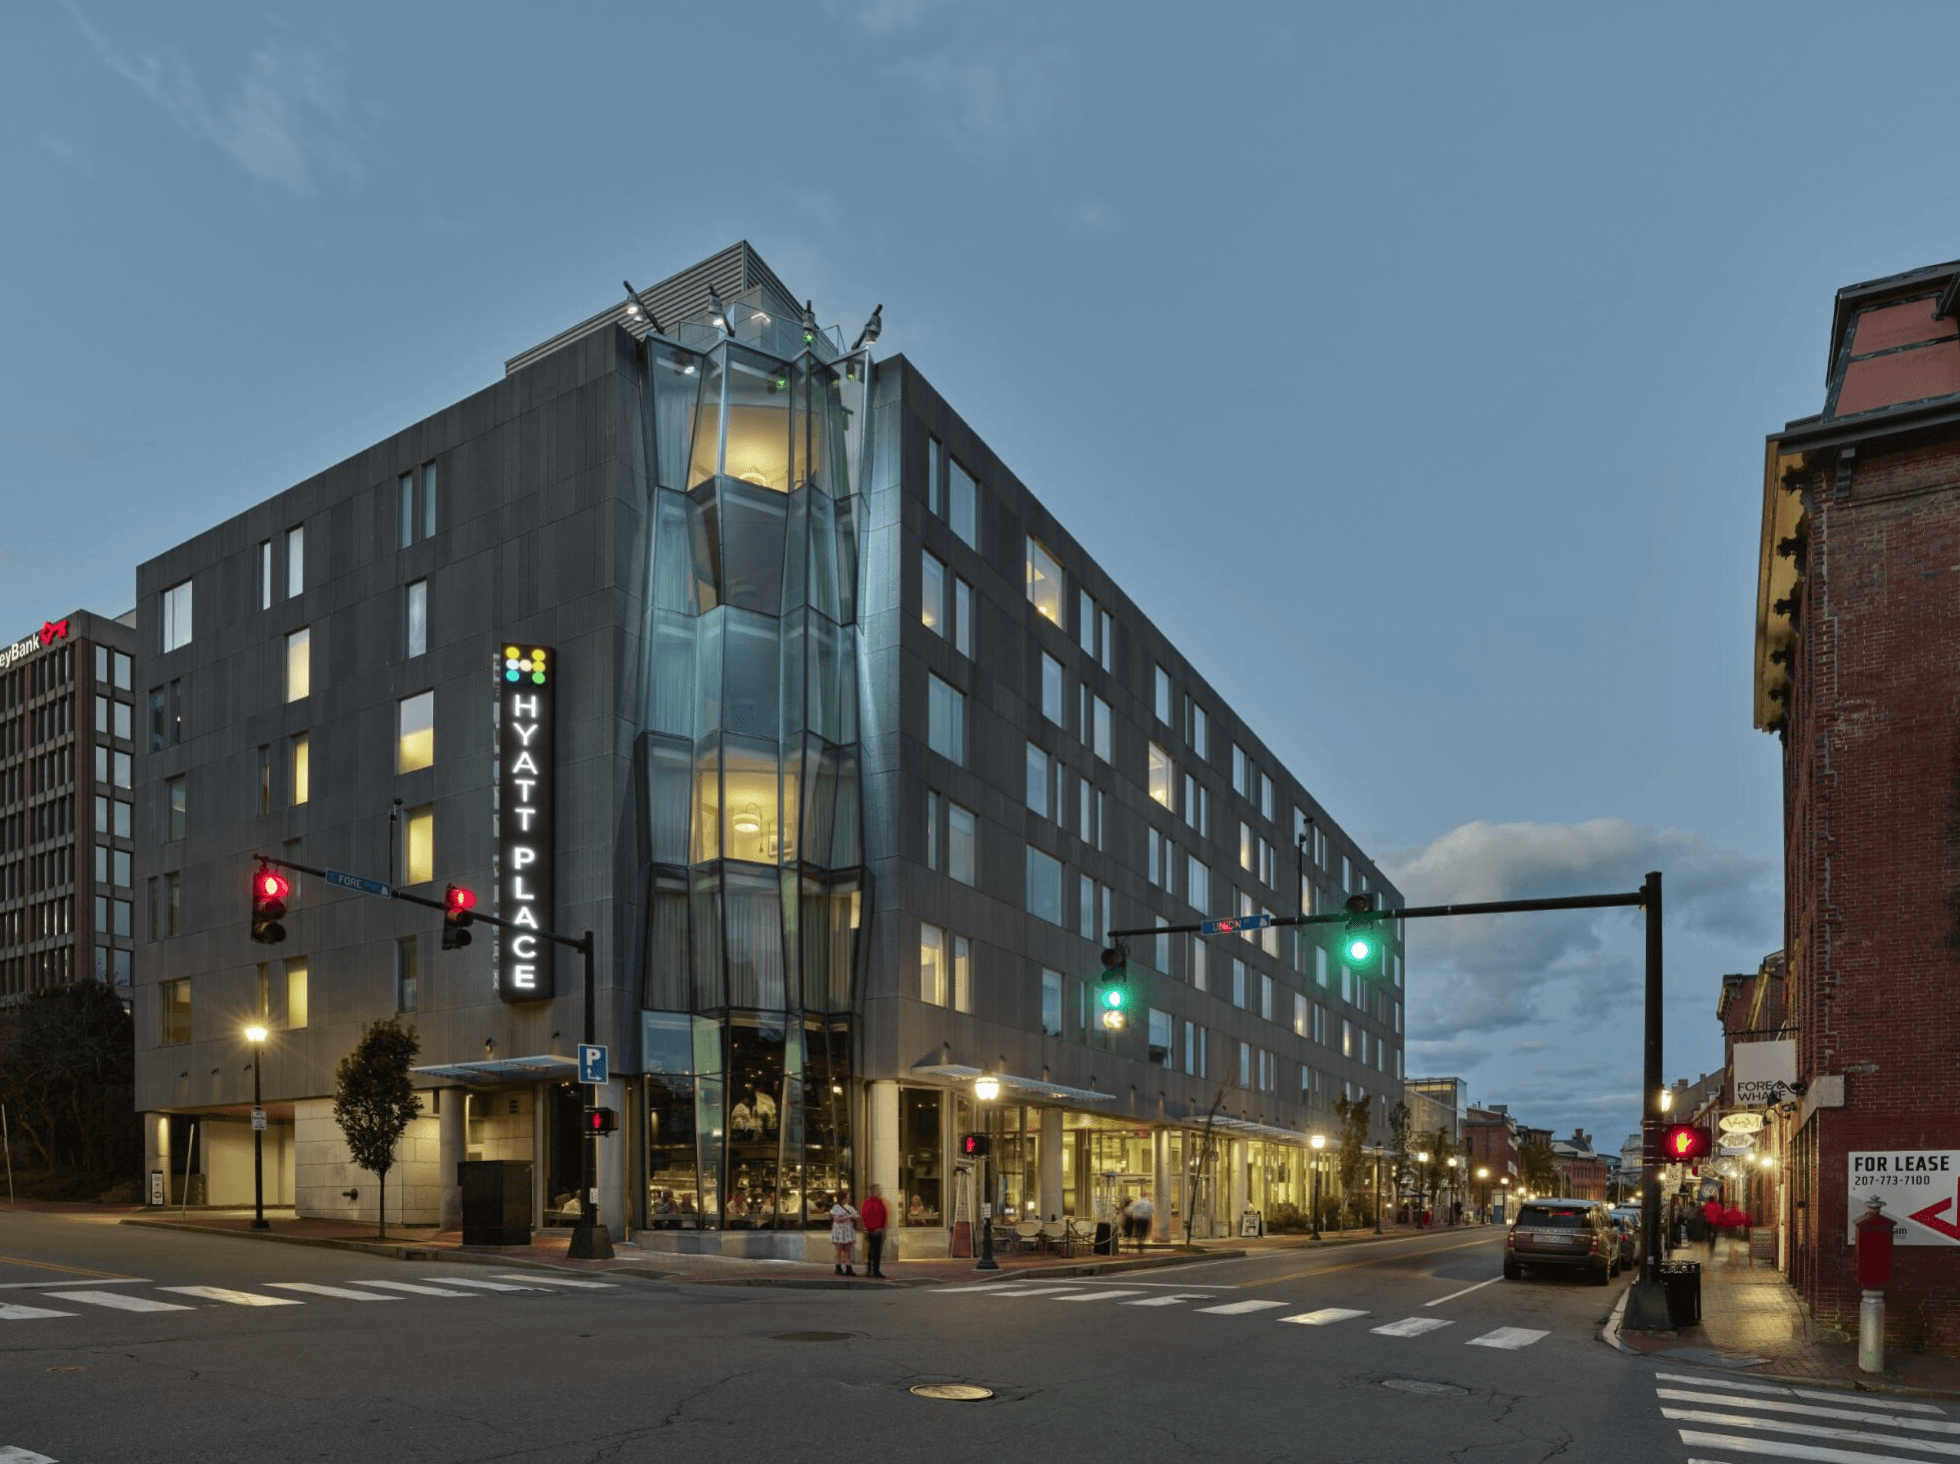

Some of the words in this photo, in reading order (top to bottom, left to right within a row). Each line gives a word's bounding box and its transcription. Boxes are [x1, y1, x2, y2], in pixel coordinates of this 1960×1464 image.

[512, 694, 538, 831] HYATT
[338, 874, 362, 889] FORE
[512, 847, 538, 988] PLACE
[1212, 919, 1241, 932] UNON
[586, 1048, 601, 1066] P
[1737, 1081, 1773, 1092] FORE
[1854, 1156, 1888, 1172] FOR
[1895, 1155, 1950, 1171] LEASE
[1854, 1175, 1930, 1186] 207-773-7100
